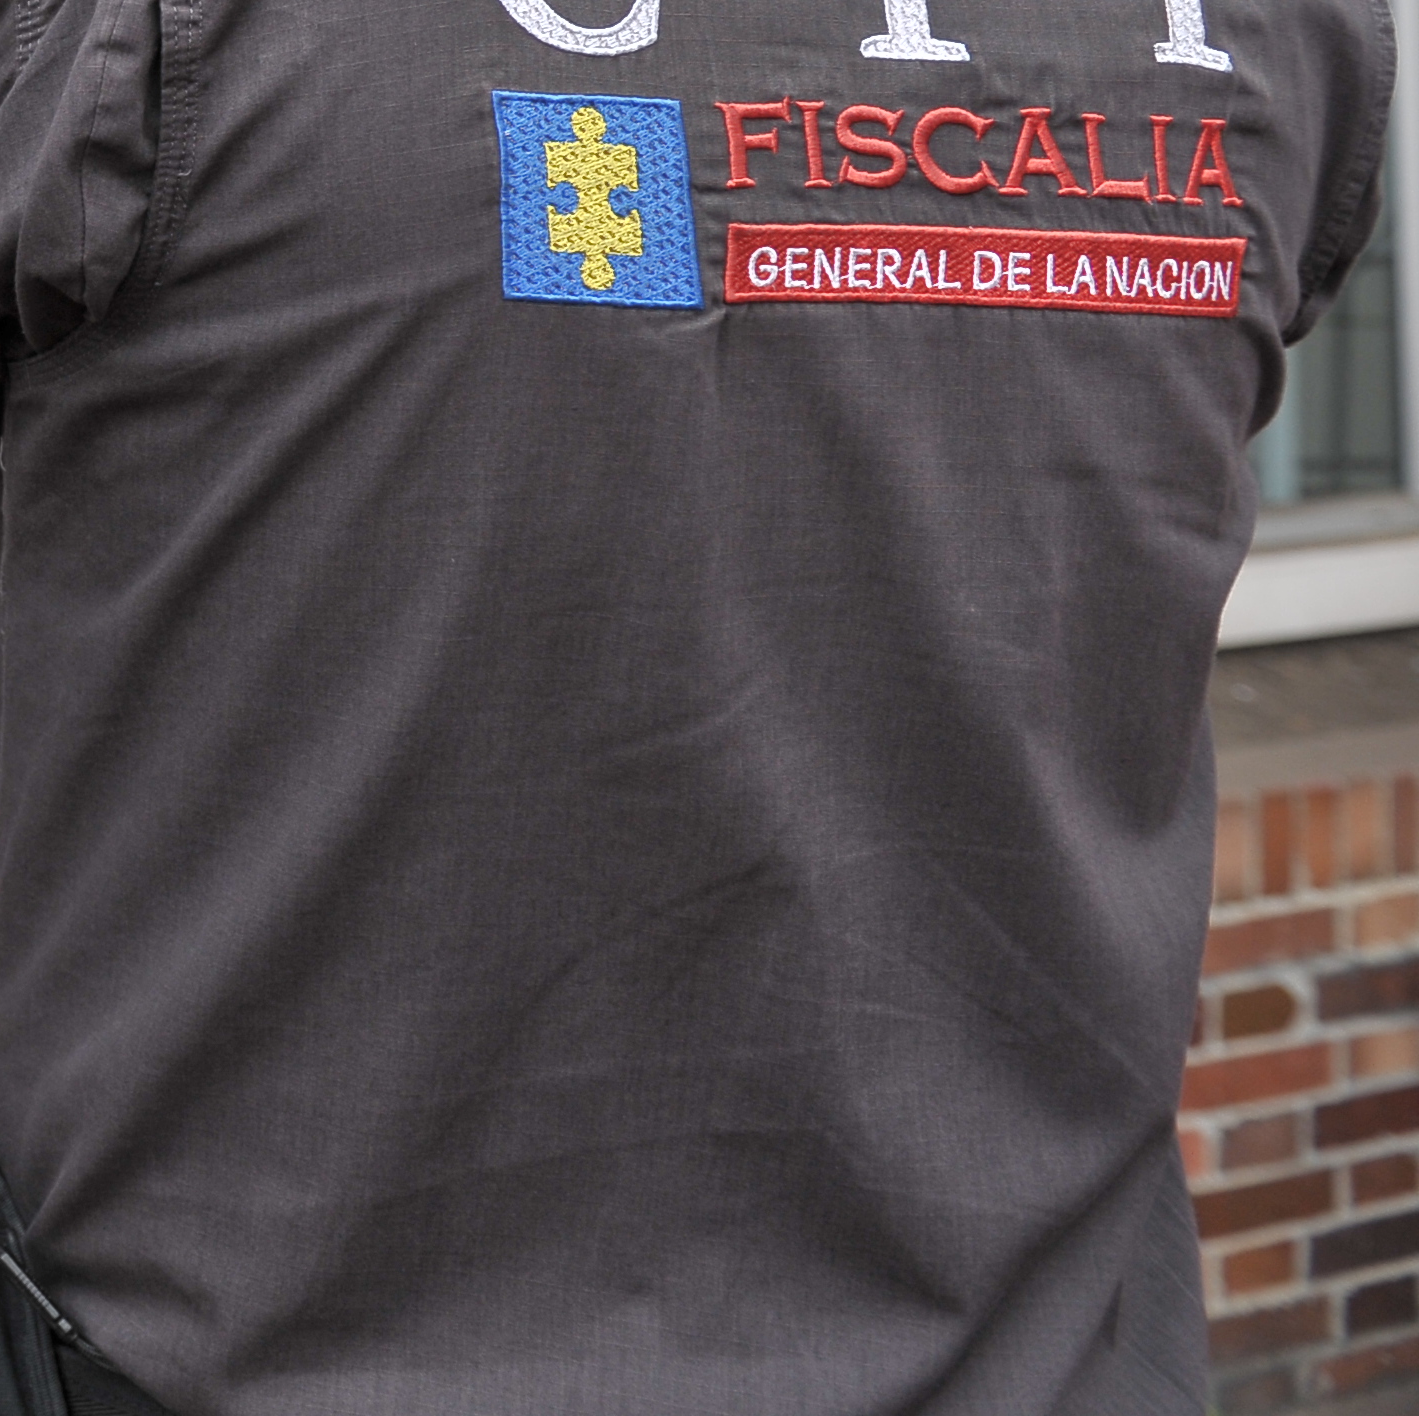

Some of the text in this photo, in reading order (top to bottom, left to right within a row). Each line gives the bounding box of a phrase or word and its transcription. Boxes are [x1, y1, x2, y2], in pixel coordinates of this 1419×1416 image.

[714, 97, 1245, 206] FISCALIA
[747, 246, 1234, 302] GENERAL DE LA NACION
